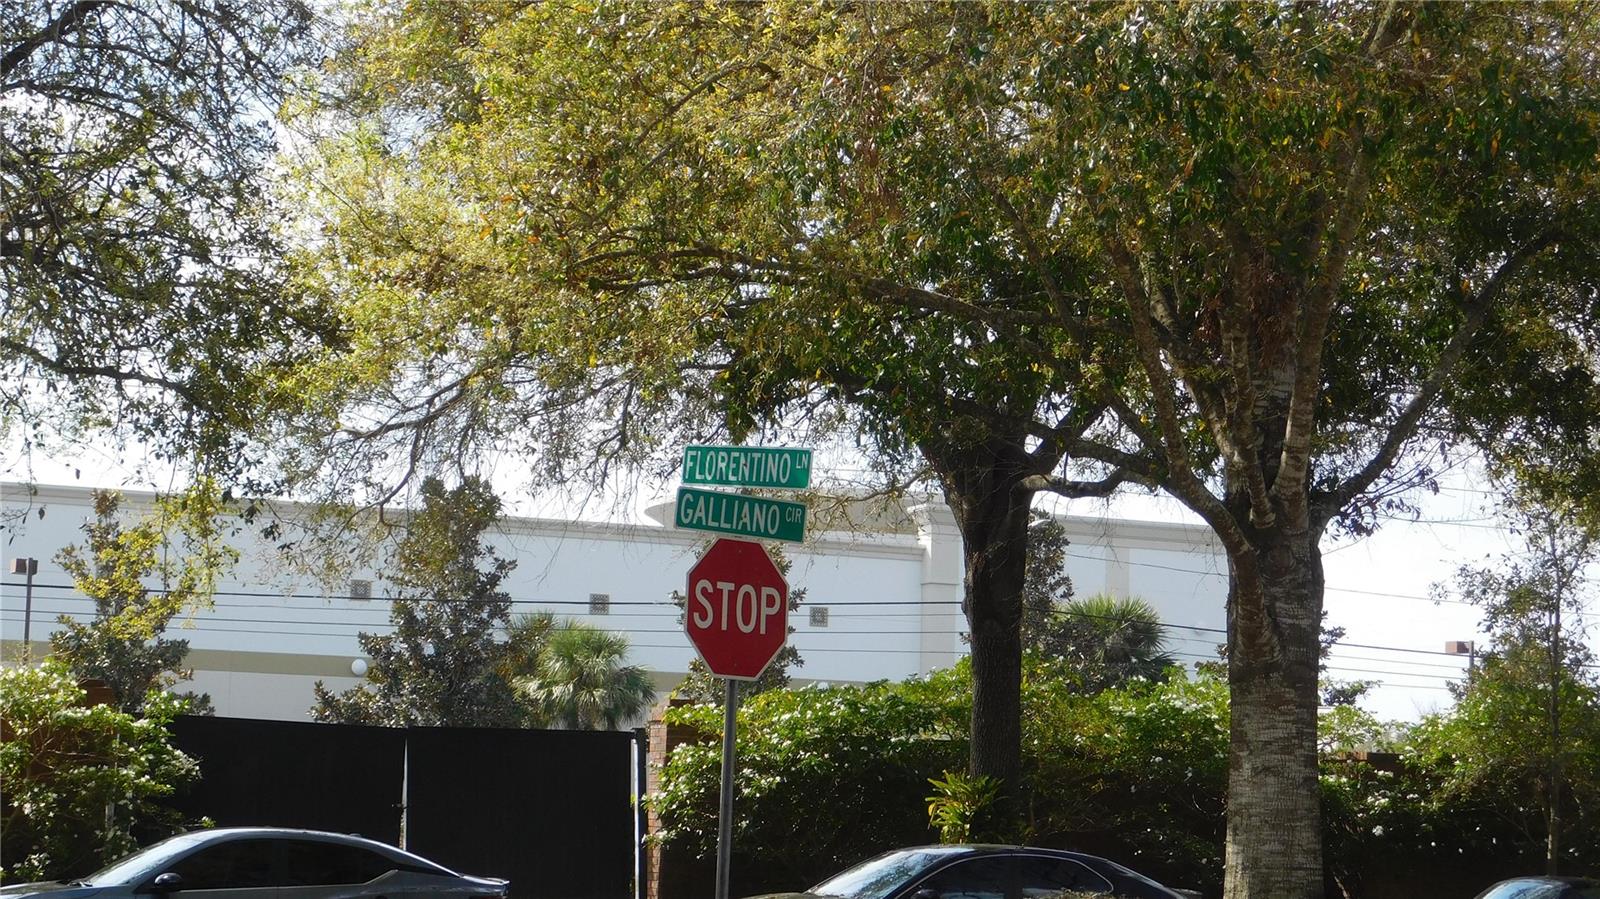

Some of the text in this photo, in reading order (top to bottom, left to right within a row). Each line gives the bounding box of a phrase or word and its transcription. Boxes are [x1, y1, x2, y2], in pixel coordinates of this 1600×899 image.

[685, 450, 809, 484] FLORENTINO LN
[680, 493, 802, 535] GALLIANO CIR
[693, 579, 781, 635] STOP
